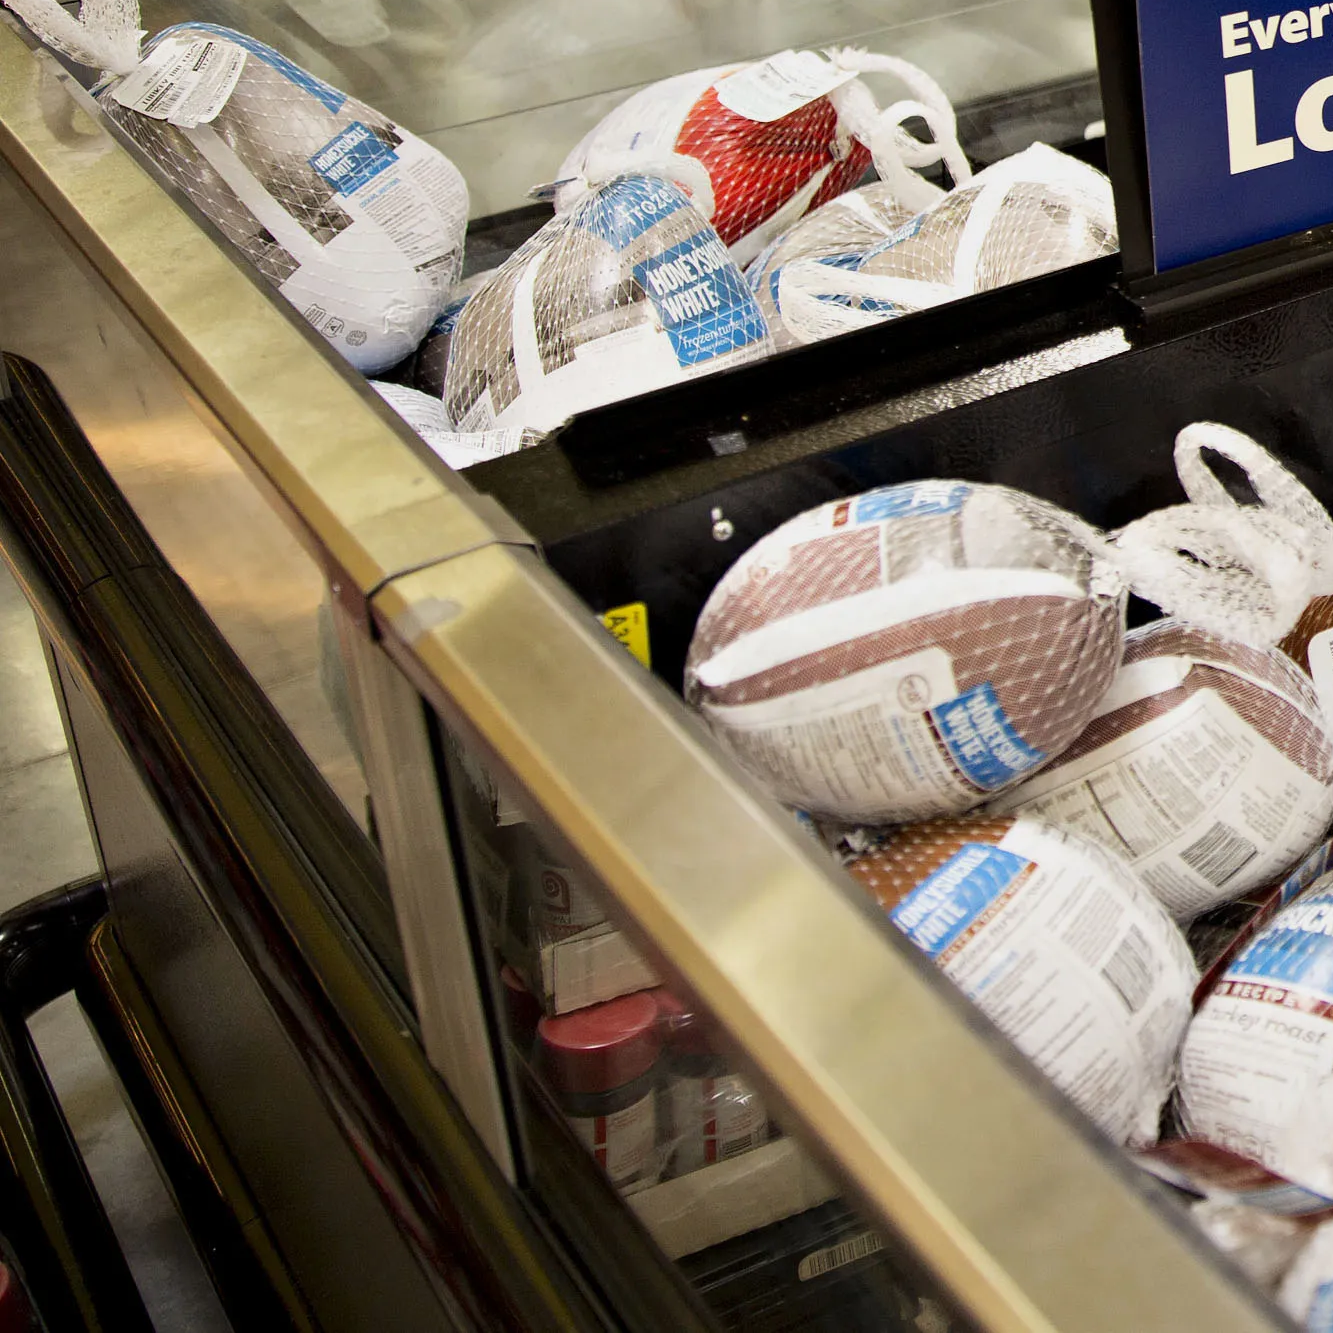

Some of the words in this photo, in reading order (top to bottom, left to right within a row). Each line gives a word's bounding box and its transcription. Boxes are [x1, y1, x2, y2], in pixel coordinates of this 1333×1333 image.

[326, 157, 356, 182] WHITE
[661, 278, 701, 324] WHITE
[1265, 1016, 1329, 1047] roast
